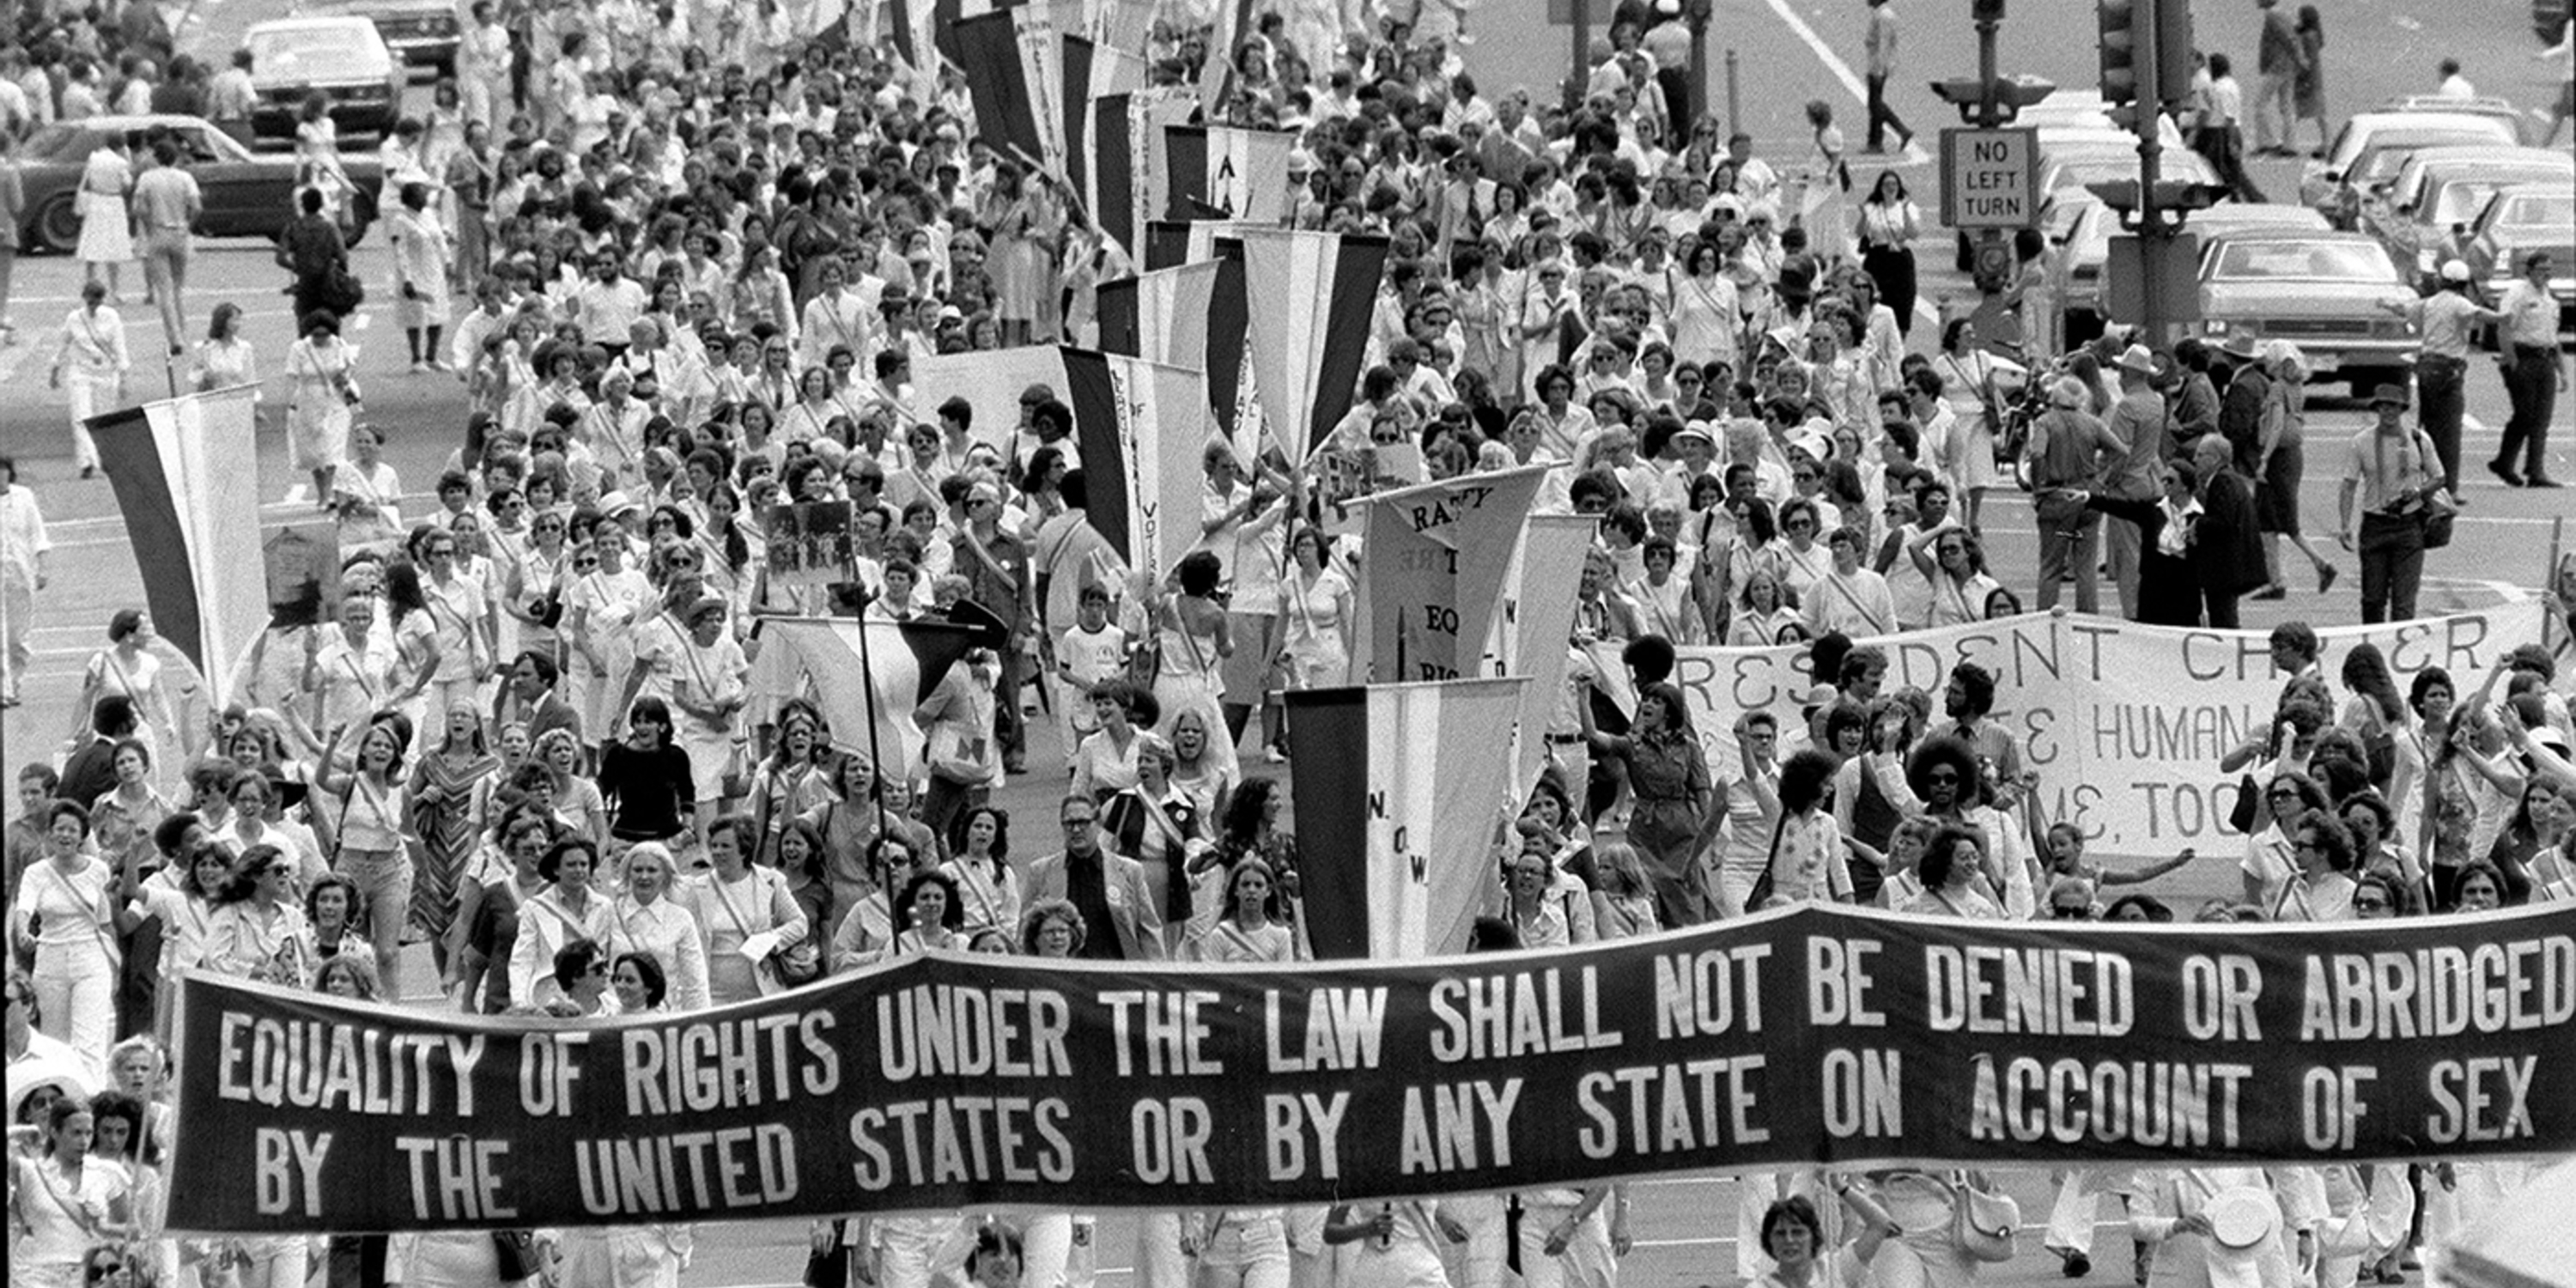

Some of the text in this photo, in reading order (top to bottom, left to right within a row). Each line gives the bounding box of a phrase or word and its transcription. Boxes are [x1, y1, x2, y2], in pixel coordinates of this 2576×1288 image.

[1975, 141, 2008, 162] NO
[1966, 171, 2016, 190] LEFT
[1965, 197, 2020, 216] TURN
[2093, 704, 2250, 761] HUMAN
[218, 935, 2576, 1118] EQUALITY OF RIGHTS UNDER THE LAW SHALL NOT BE DENIED OR ABRIDGED
[255, 1048, 2537, 1220] BY THE UNITED STATES OR BY ANY STATE ON ACCOUNT OF SEX
